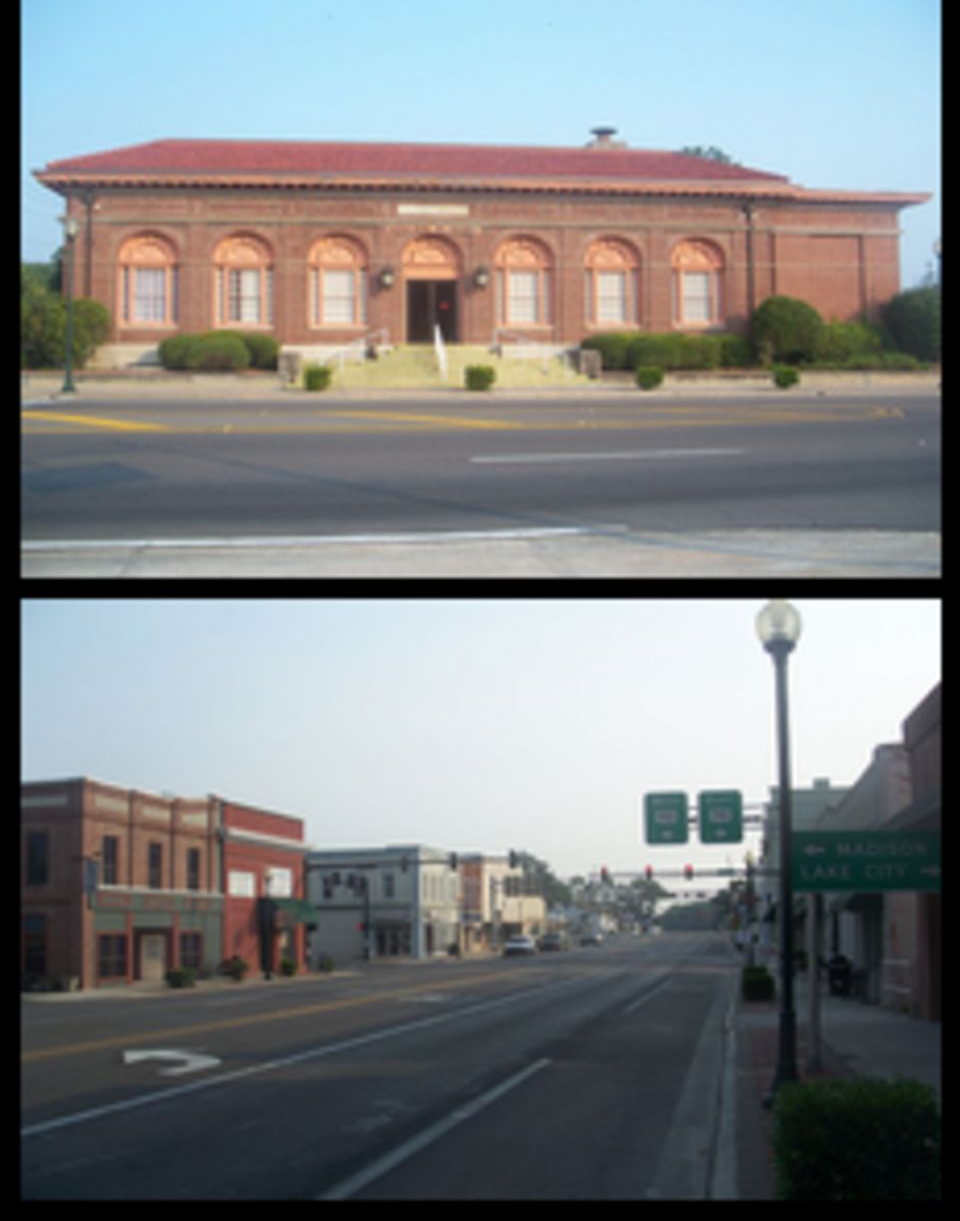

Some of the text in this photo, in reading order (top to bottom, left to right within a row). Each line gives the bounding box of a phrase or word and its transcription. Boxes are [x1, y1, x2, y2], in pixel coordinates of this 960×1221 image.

[835, 841, 926, 856] MADISON
[800, 863, 909, 880] LAKE CITY
